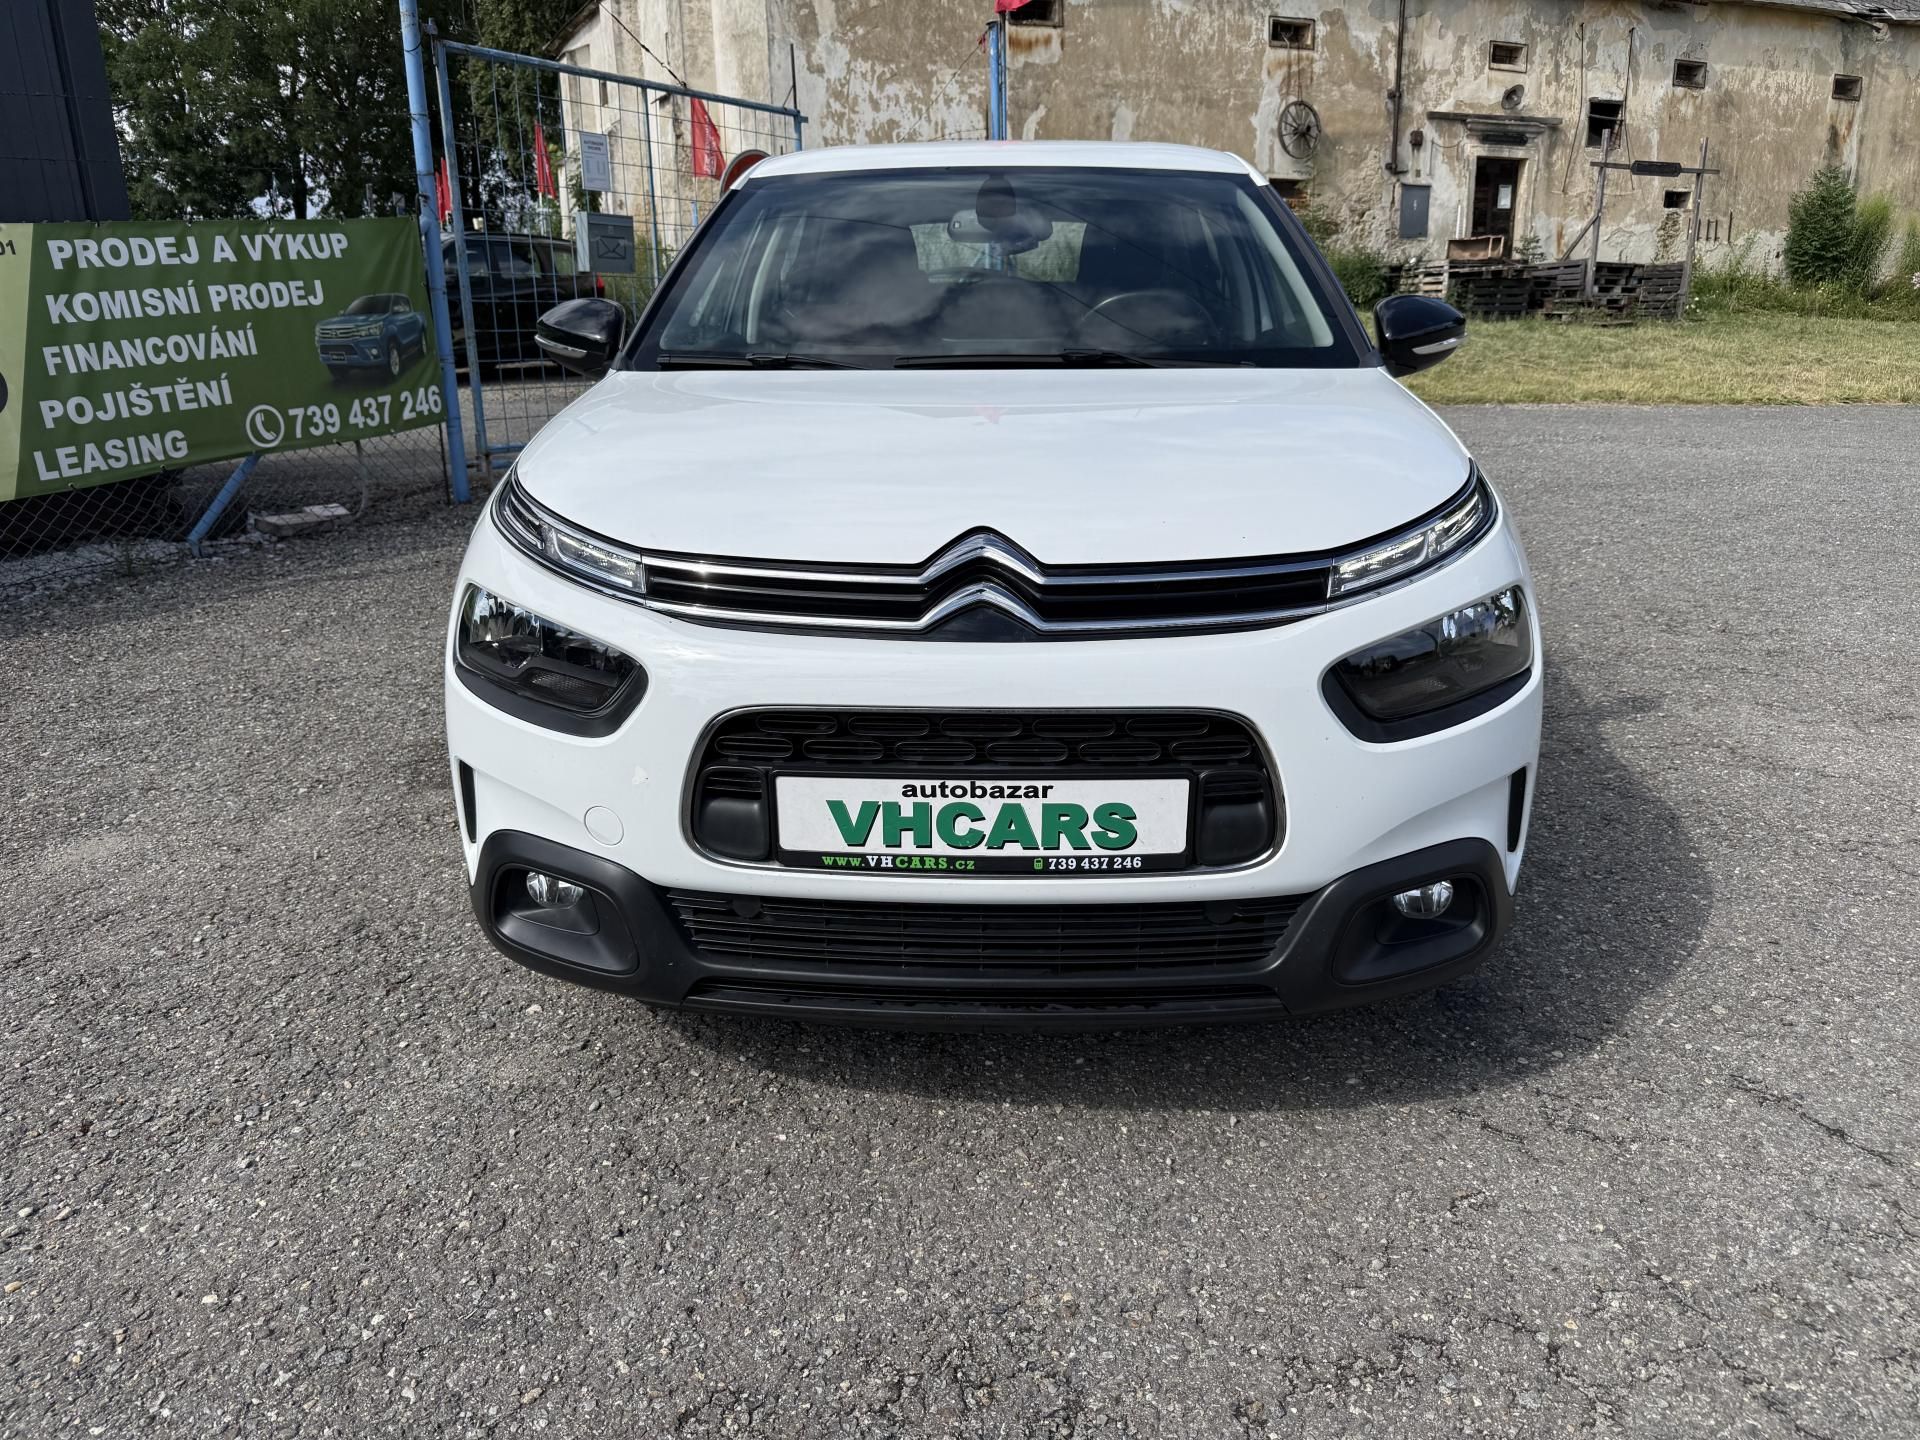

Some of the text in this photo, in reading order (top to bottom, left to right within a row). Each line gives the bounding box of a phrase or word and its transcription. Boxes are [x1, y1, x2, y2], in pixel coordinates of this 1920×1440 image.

[47, 228, 349, 270] PRODEJ A VÝKUP
[45, 279, 324, 324] KOMISNÍ PRODEJ
[43, 322, 258, 376] FINANCOVÁNÍ
[39, 372, 233, 429] POJIŠTĚNÍ
[288, 384, 442, 438] 739 437 246
[33, 429, 188, 481] LEASING
[901, 781, 1054, 799] autobazar
[825, 799, 1138, 851] VHCARS
[821, 855, 1142, 870] www.VHCARS.cz 739 437 246
